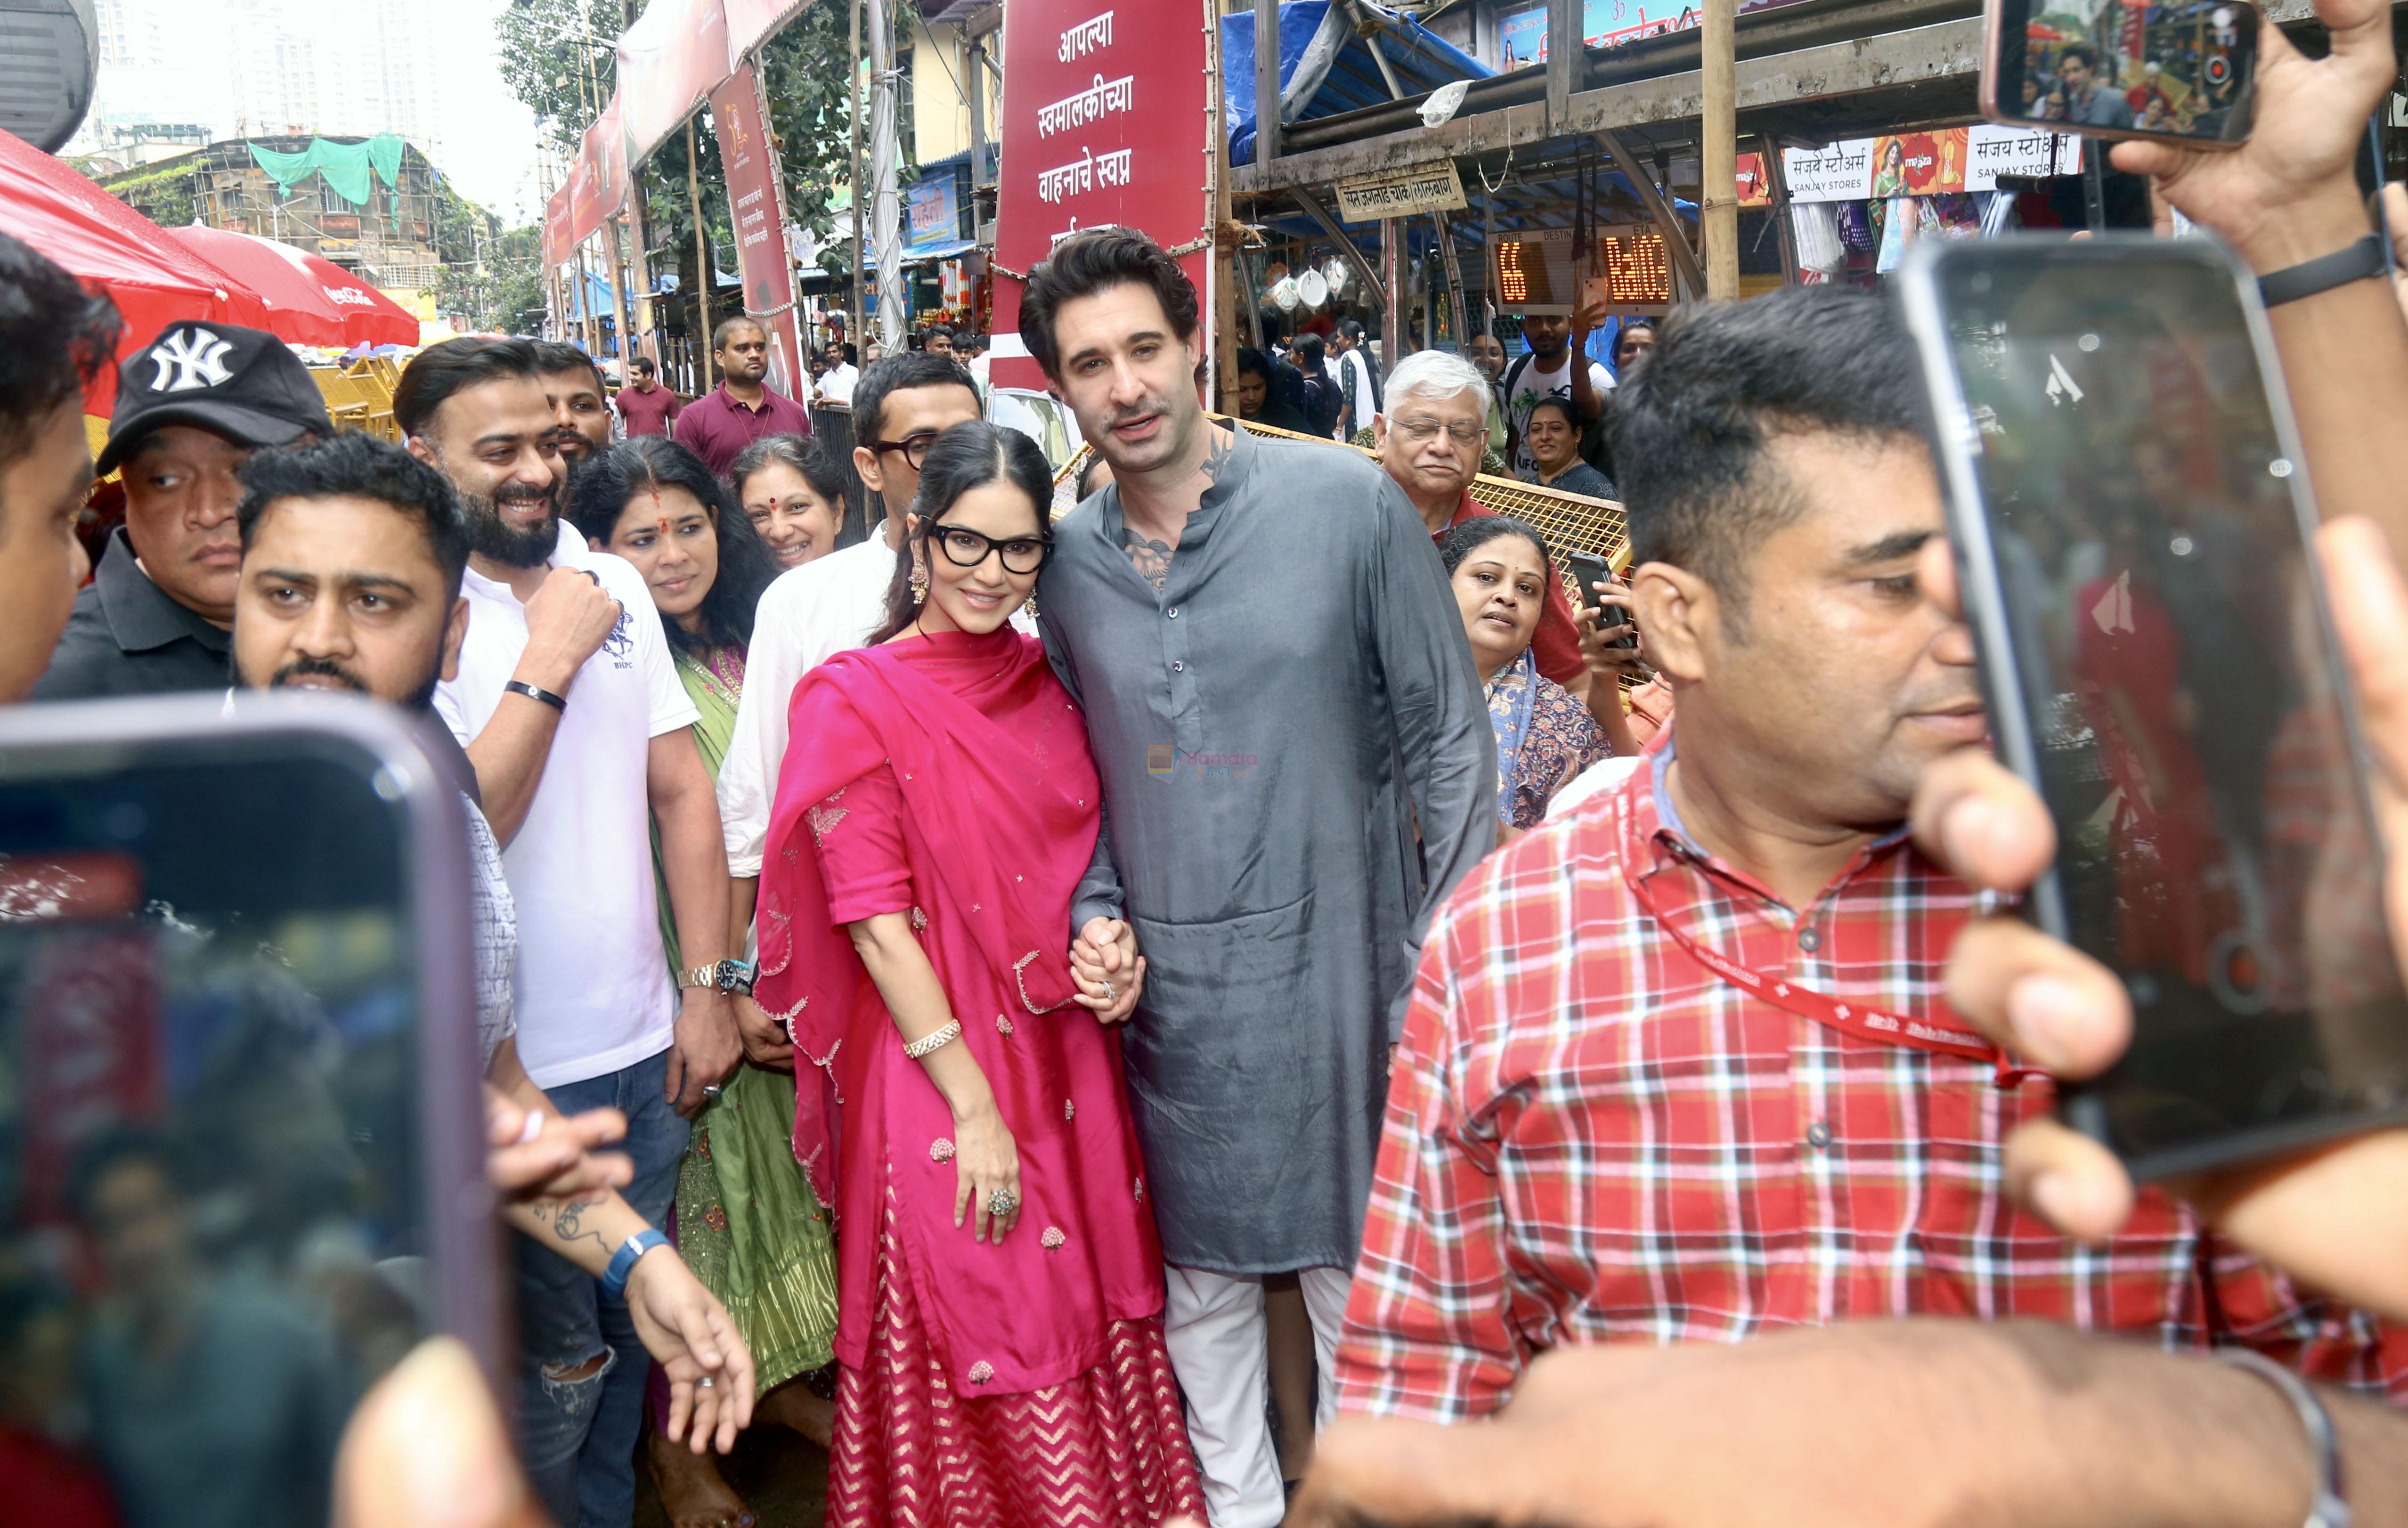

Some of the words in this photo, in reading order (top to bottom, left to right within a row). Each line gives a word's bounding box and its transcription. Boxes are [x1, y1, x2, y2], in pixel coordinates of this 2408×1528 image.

[1058, 10, 1114, 63] आपल्या
[1038, 73, 1134, 139] स्वमालकीच्या
[1976, 137, 2013, 159] संजय
[1792, 156, 1822, 176] संजय
[1905, 156, 1932, 168] maaza
[1038, 146, 1093, 205] वाहनाचे
[1096, 148, 1132, 189] स्वप्न
[1794, 182, 1826, 193] SANJAY
[1829, 179, 1861, 190] STORES
[1498, 233, 1522, 243] ROUTE
[1634, 225, 1651, 235] ETA
[1500, 242, 1526, 301] 66
